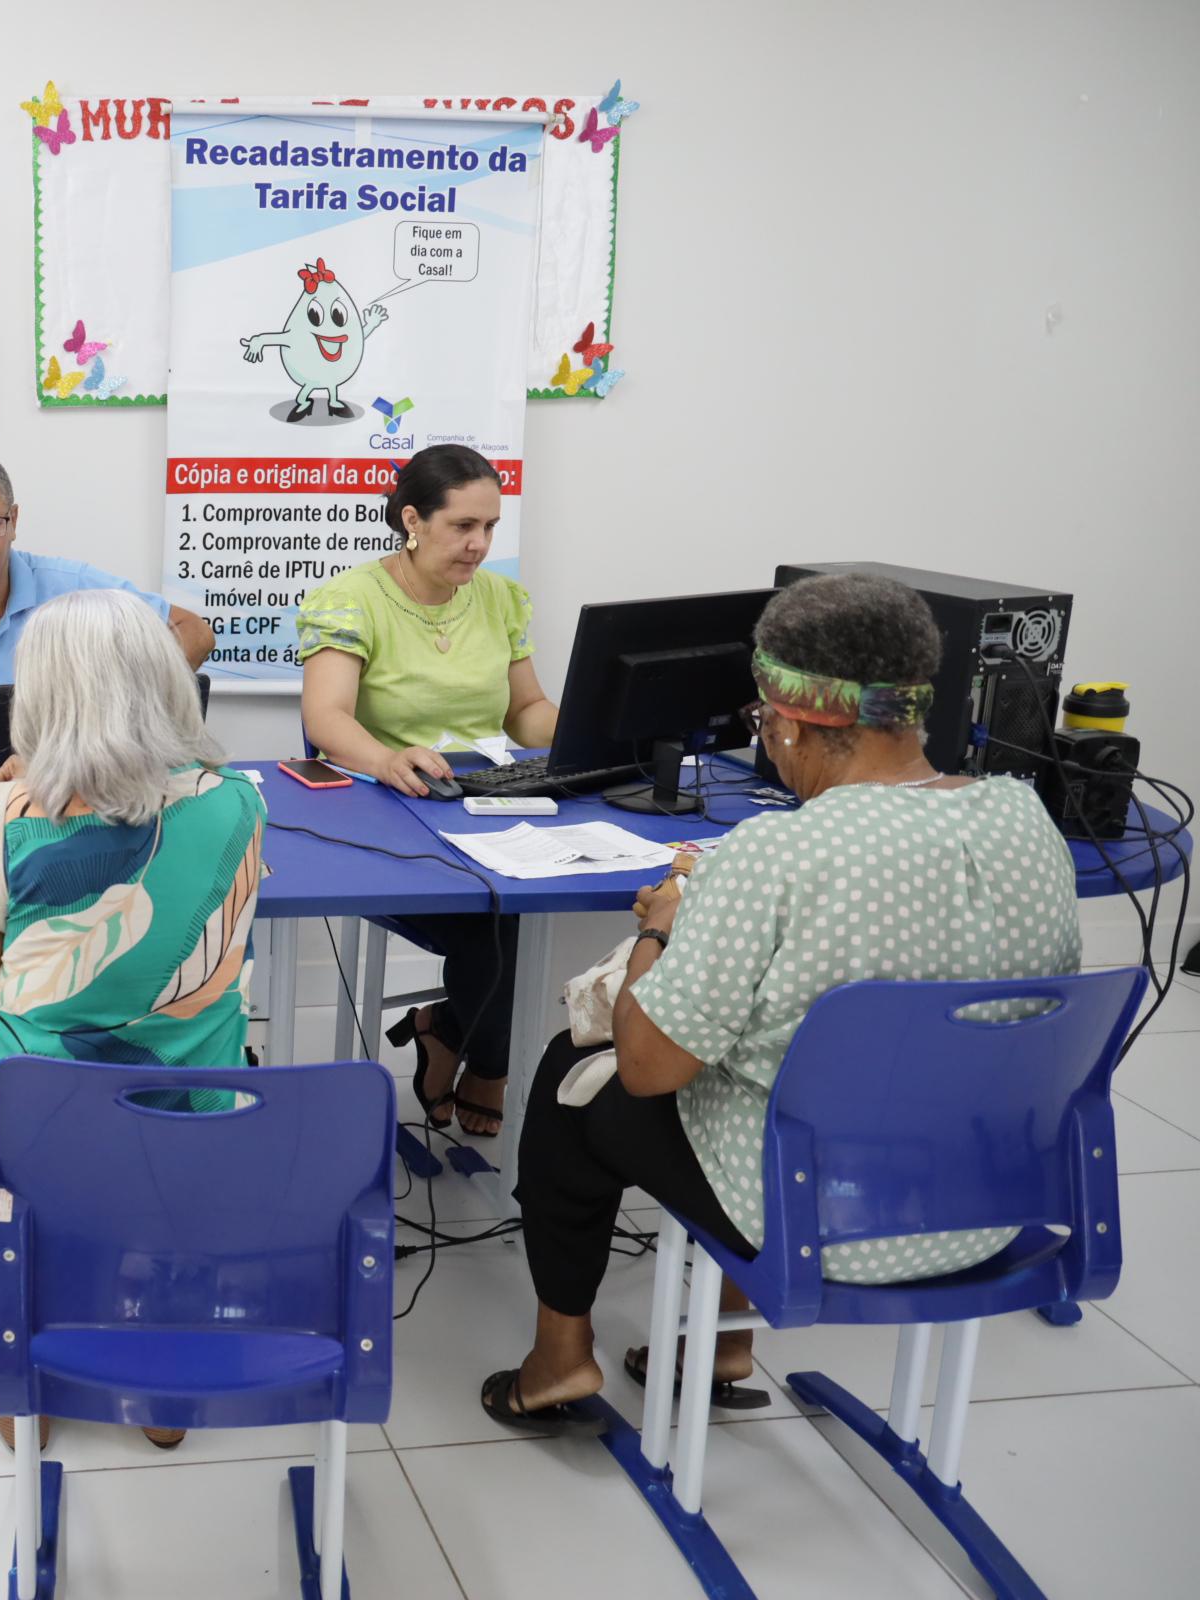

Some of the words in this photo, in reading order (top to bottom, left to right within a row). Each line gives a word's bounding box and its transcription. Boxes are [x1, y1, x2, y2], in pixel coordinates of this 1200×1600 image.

[186, 138, 479, 171] Recadastramento
[488, 146, 527, 173] da
[255, 183, 347, 211] Tarifa
[357, 185, 456, 213] Social
[413, 226, 442, 240] Fique
[445, 229, 462, 239] em
[411, 246, 427, 256] dia
[430, 248, 452, 258] com
[456, 249, 462, 258] a
[419, 264, 452, 276] Casal!
[369, 434, 413, 450] Casal
[175, 463, 230, 488] Cópia
[237, 469, 248, 484] e
[254, 464, 327, 488] original
[333, 465, 358, 484] da
[182, 504, 196, 521] 1.
[203, 504, 321, 525] Comprovante
[327, 504, 349, 522] do
[355, 505, 387, 522] Bol
[179, 533, 196, 550] 2.
[203, 533, 320, 553] Comprovante
[327, 533, 348, 550] de
[179, 561, 195, 578] 3.
[202, 561, 253, 578] Carnê
[258, 561, 280, 578] de
[286, 561, 324, 578] IPTU
[205, 588, 262, 606] imóvel
[267, 593, 288, 606] ou
[231, 617, 240, 634] E
[246, 617, 281, 634] CPF
[205, 646, 250, 662] onta
[256, 645, 277, 662] de
